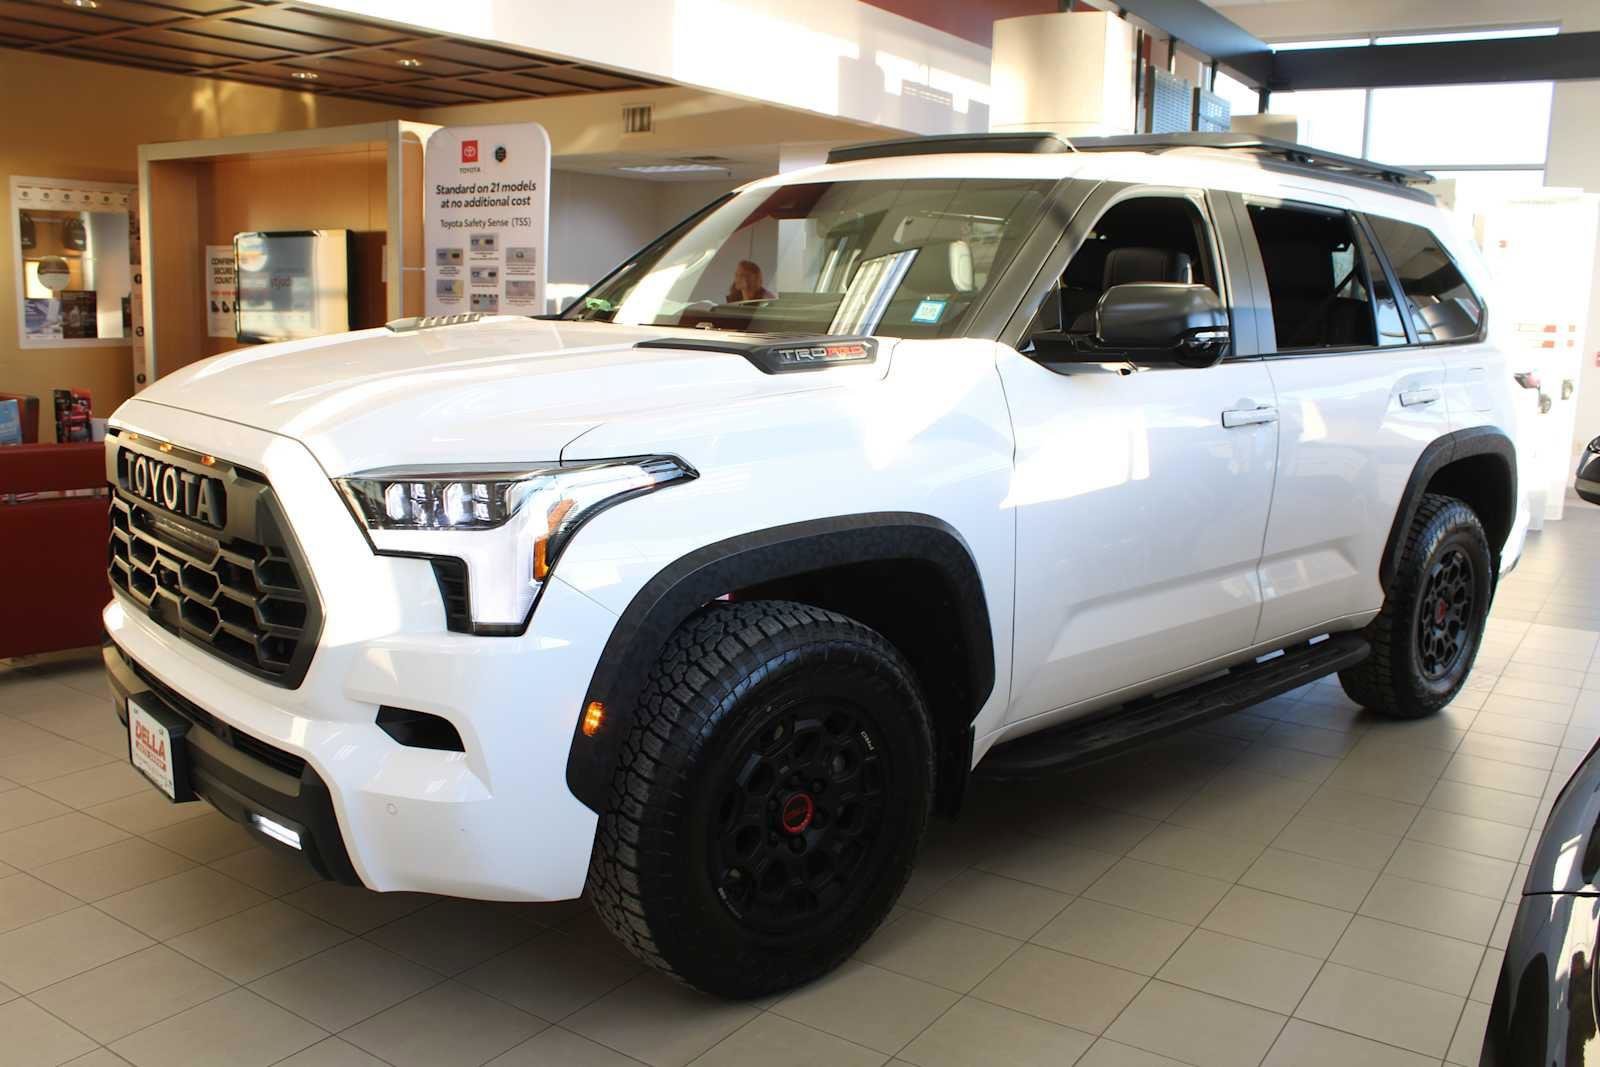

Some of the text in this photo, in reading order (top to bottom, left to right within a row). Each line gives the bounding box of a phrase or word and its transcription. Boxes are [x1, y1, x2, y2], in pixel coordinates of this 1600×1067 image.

[435, 180, 537, 195] Standard on 21 models
[440, 196, 531, 208] at no additional cost
[440, 219, 463, 229] Toyota
[464, 218, 486, 229] Safety
[487, 217, 509, 227] Sense
[778, 347, 827, 361] TRD
[124, 451, 219, 524] TOYOTA
[135, 720, 167, 761] DELLA
